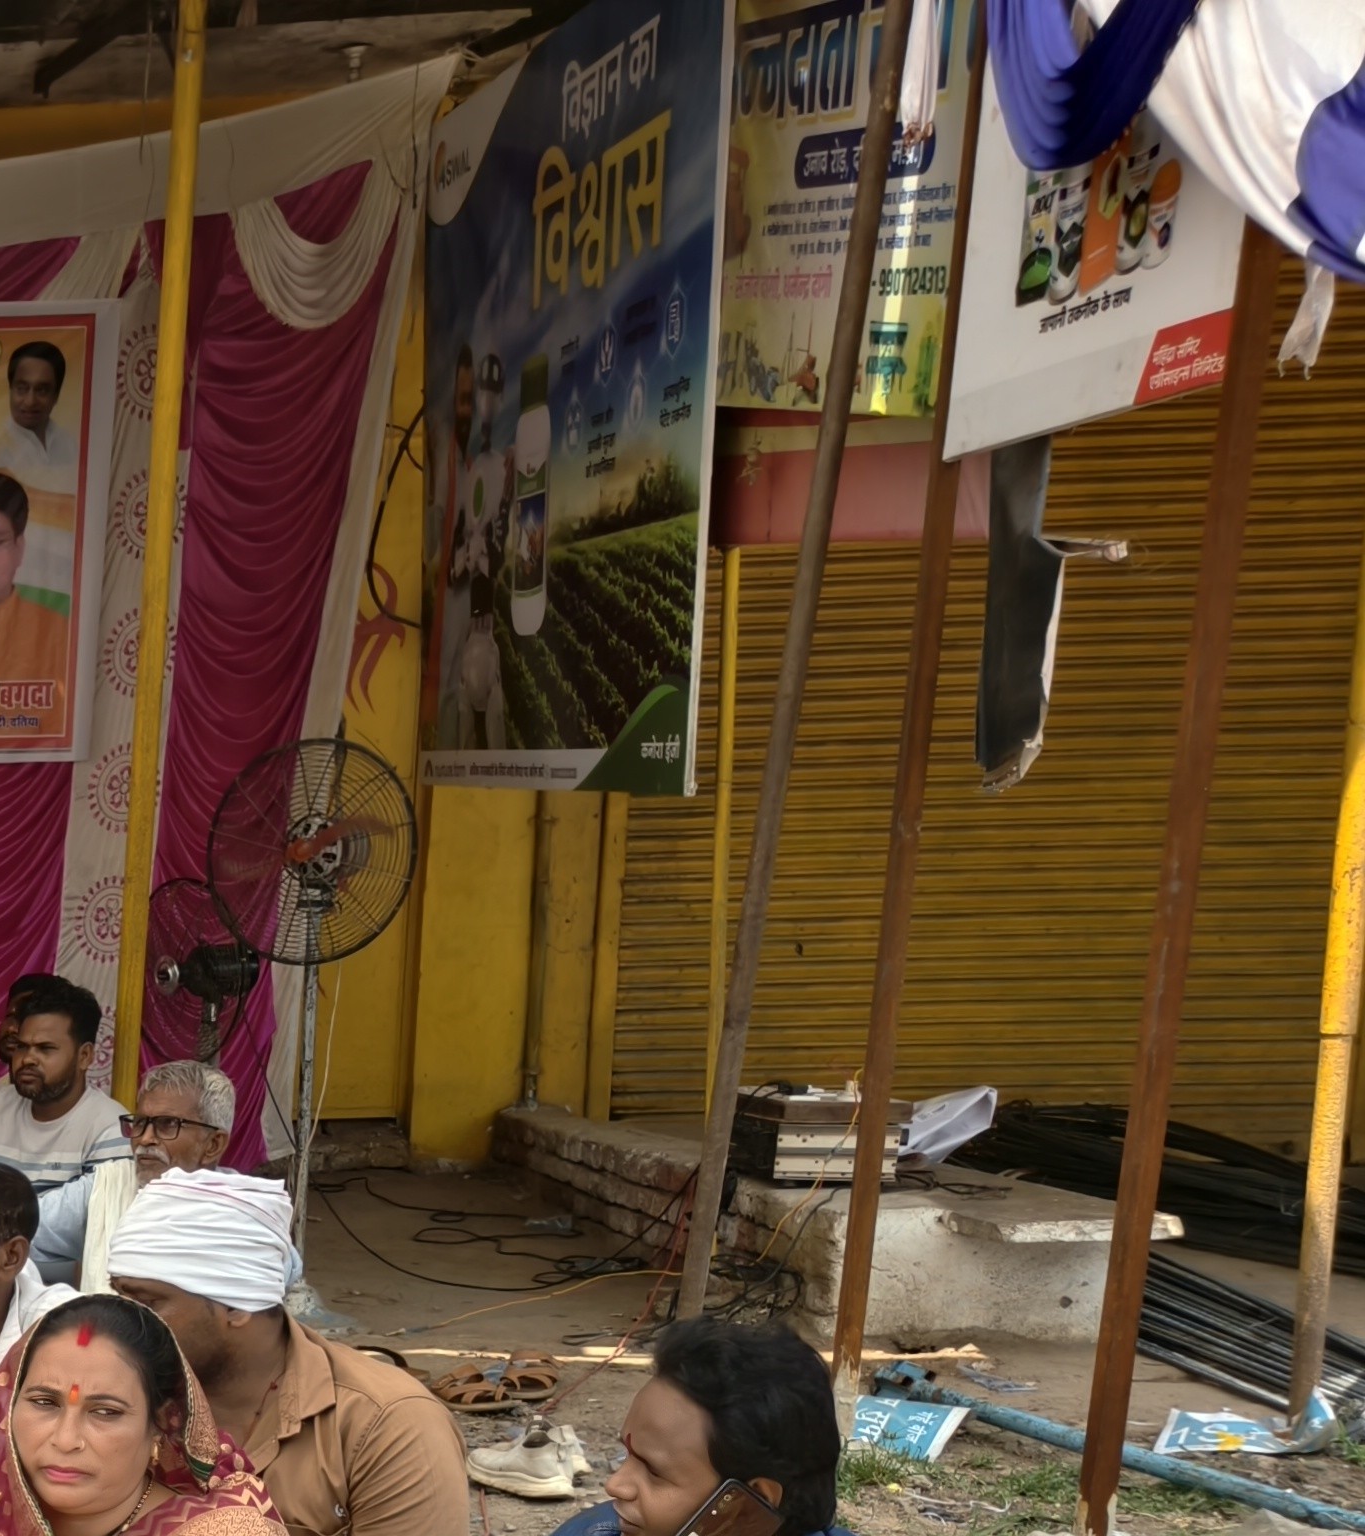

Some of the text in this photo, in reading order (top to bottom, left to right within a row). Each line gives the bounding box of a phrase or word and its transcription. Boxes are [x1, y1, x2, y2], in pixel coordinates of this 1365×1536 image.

[562, 13, 660, 141] विज्ञान का
[533, 108, 672, 310] विश्वास
[1038, 305, 1067, 334] जापानी
[1067, 296, 1100, 325] तकनीक
[1101, 290, 1112, 312] के
